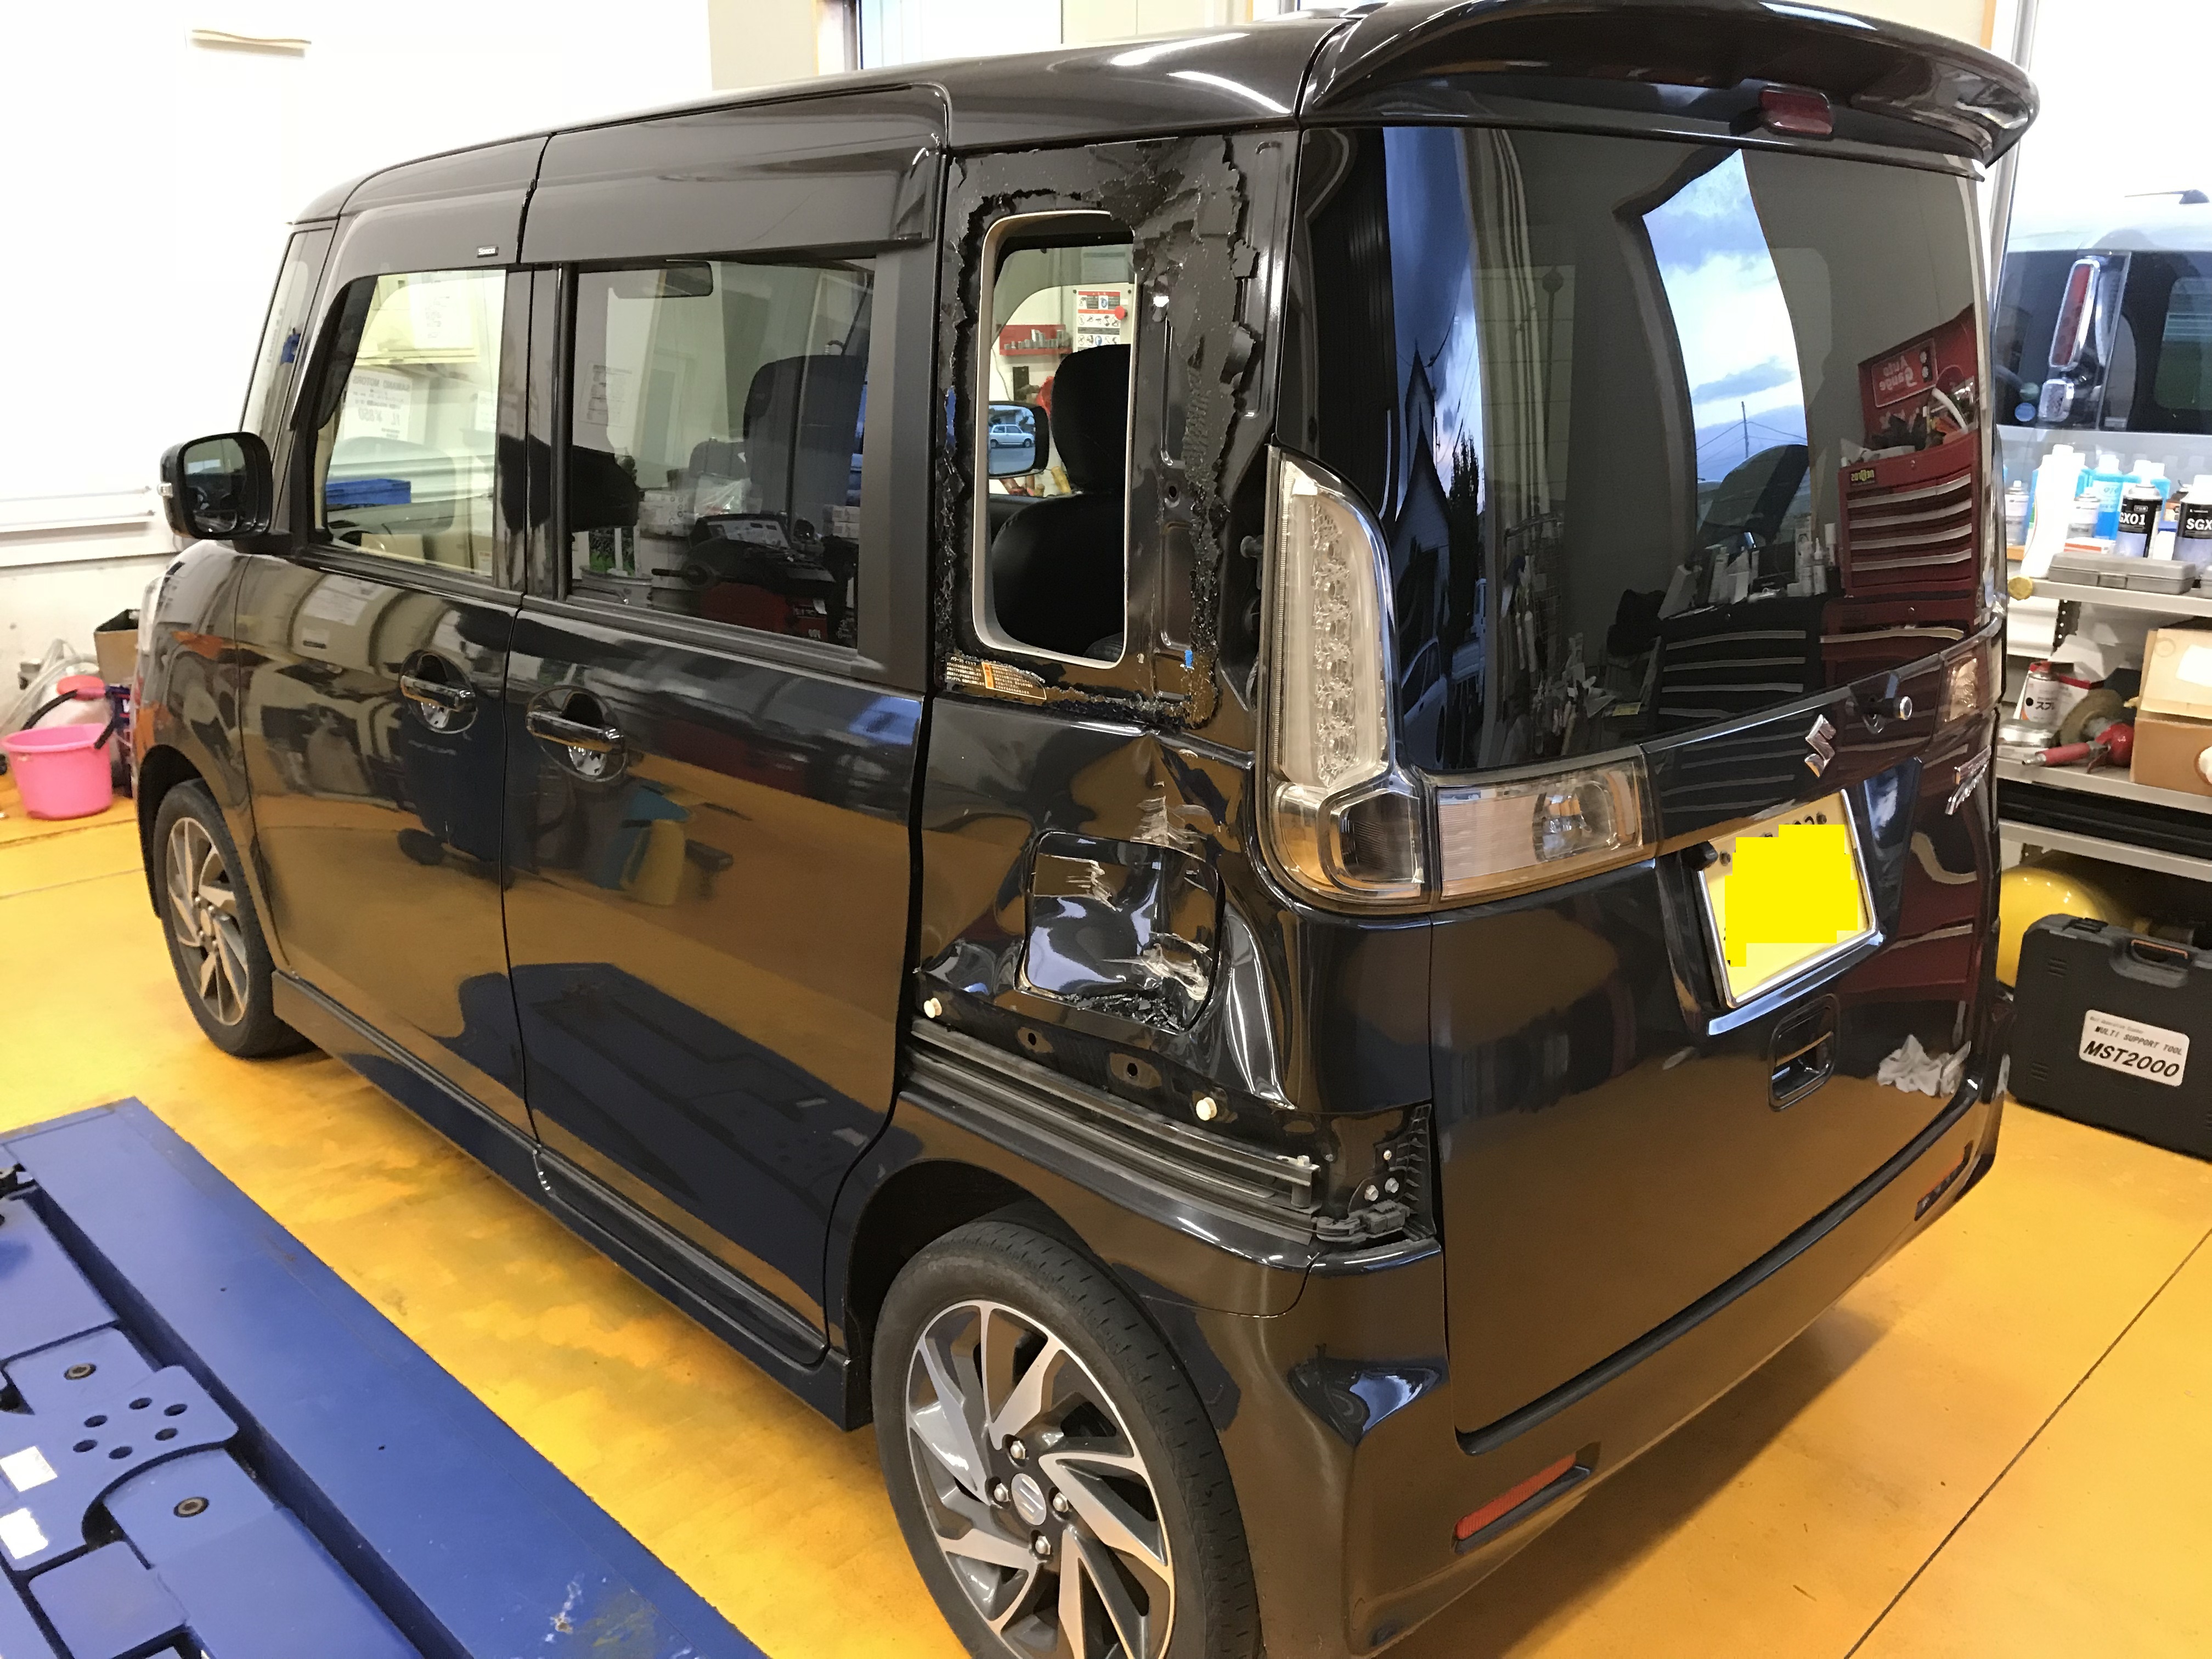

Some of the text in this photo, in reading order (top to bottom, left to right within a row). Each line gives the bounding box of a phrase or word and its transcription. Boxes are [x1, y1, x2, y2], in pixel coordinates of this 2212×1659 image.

[2095, 1026, 2182, 1056] MULTI SUPPORT TOOL
[2083, 1040, 2180, 1077] MST2000
